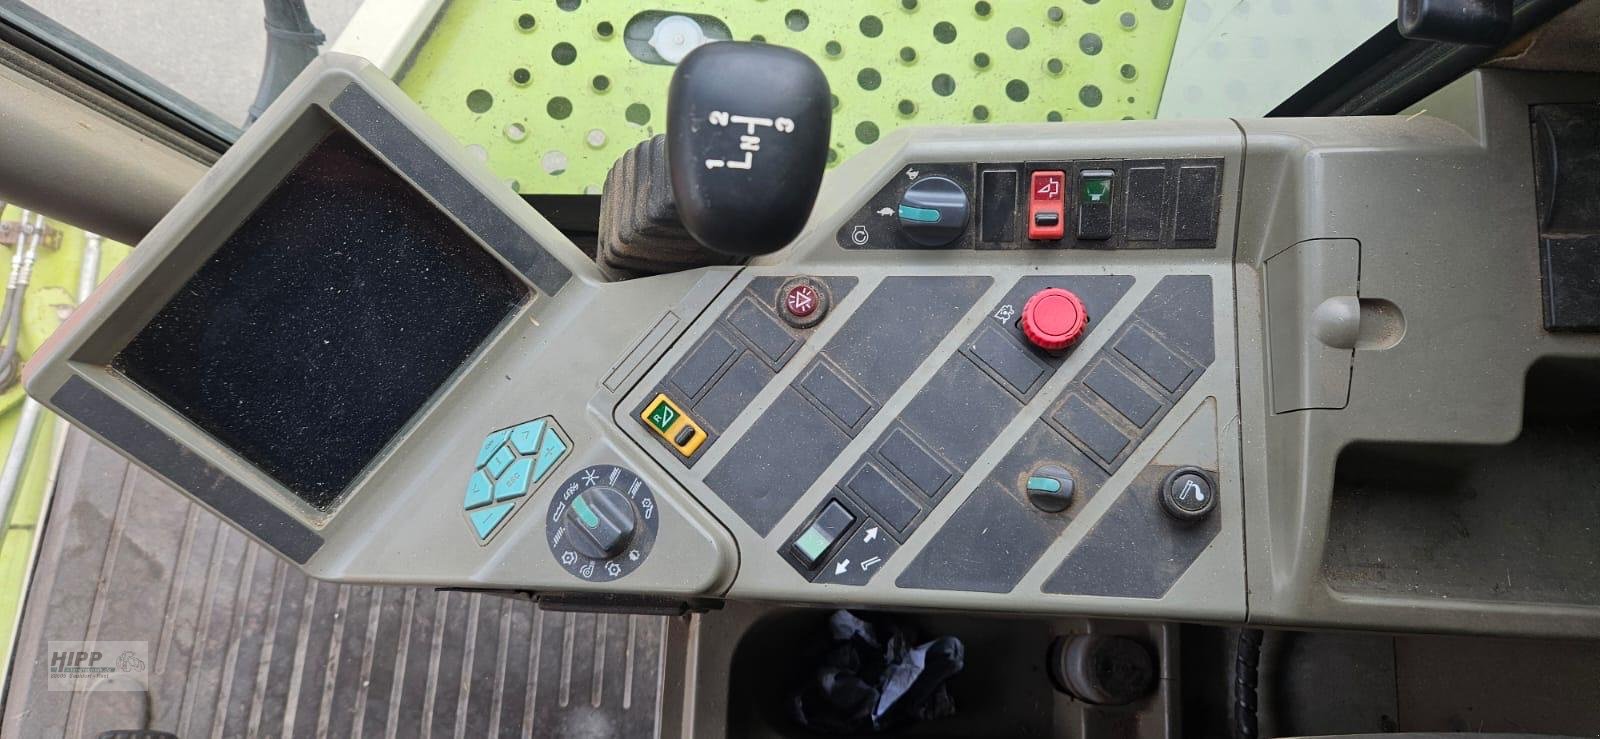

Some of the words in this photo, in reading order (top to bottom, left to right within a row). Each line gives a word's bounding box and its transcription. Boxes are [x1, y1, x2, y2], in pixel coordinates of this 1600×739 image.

[709, 110, 729, 127] 2
[774, 117, 795, 133] 3
[705, 159, 725, 170] 1
[652, 414, 662, 423] R
